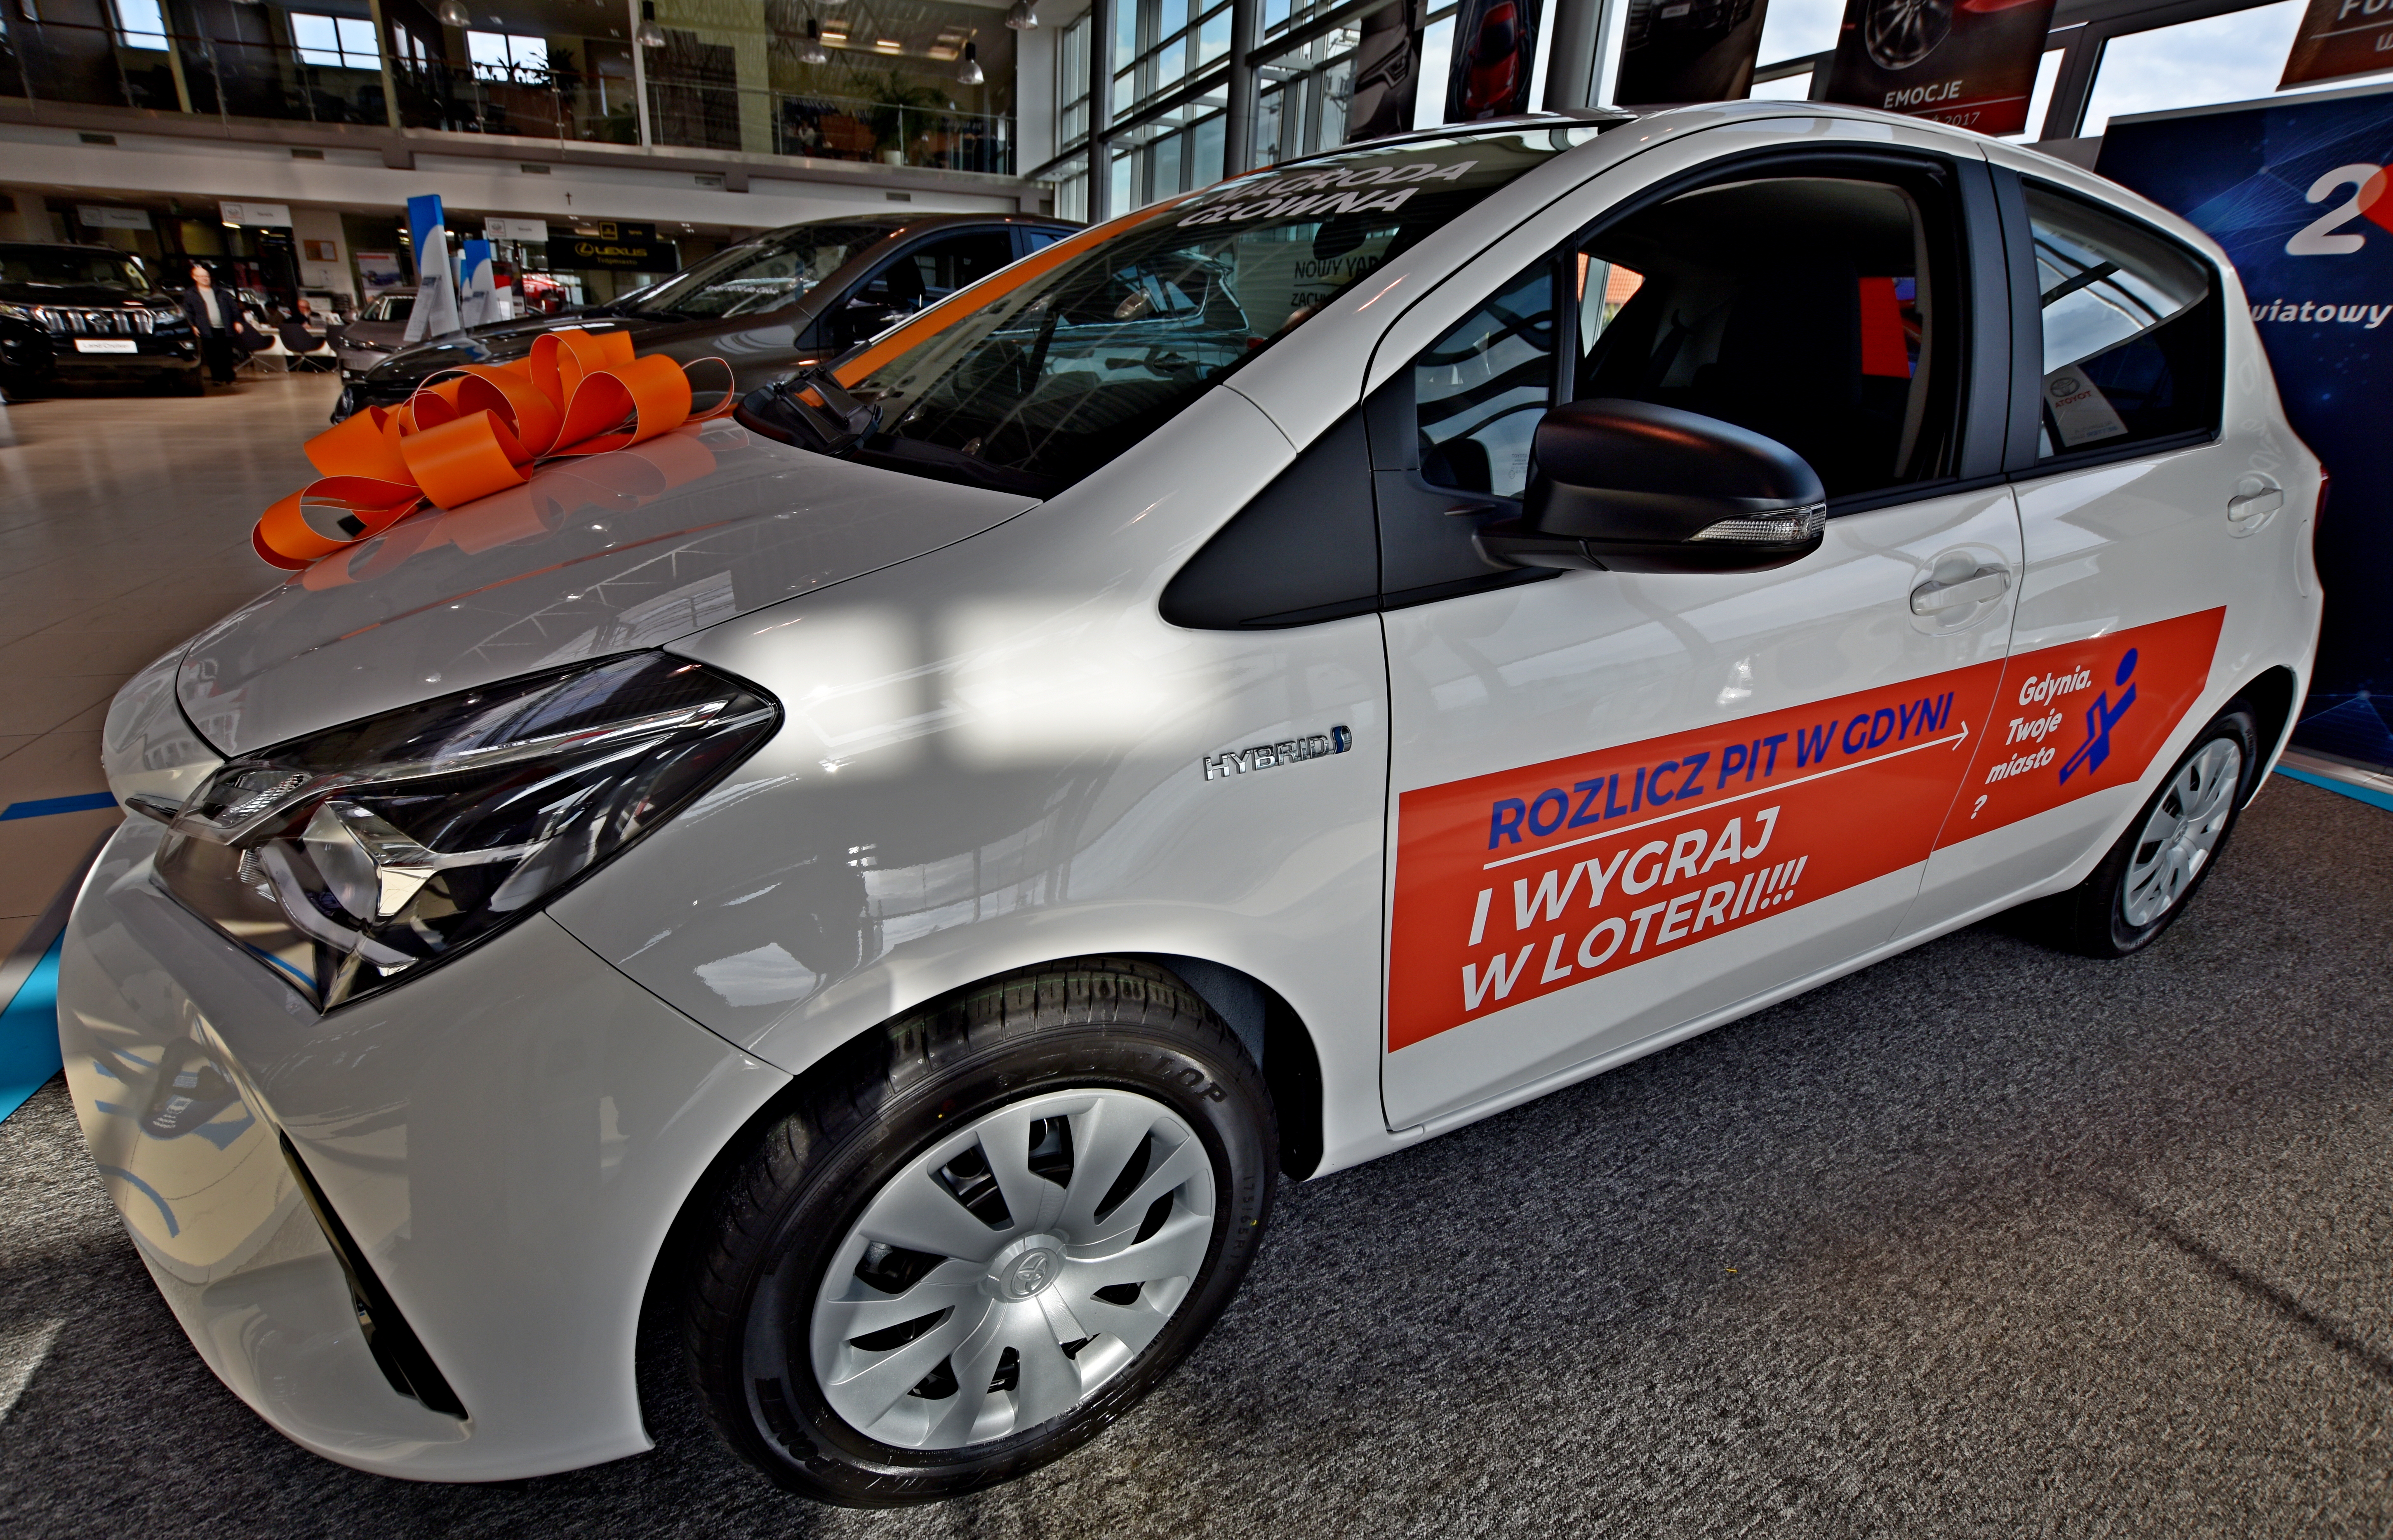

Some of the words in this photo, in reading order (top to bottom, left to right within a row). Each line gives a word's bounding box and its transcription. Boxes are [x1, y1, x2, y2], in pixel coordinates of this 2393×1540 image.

[1883, 80, 1963, 110] EMOCJE
[1945, 111, 1981, 127] 2017
[1202, 160, 1479, 205] NAGRODA
[595, 246, 648, 257] LEXUS
[1294, 259, 1343, 279] NOWY
[1346, 256, 1380, 277] YAR
[2249, 299, 2393, 329] wiatowy
[2019, 665, 2092, 706] Gdynia.
[2005, 708, 2062, 745] Twoje
[1202, 735, 1330, 781] HYBRID
[1488, 752, 1711, 850] ROZLICZ
[1717, 734, 1788, 790] PIT
[1797, 720, 1838, 768] W
[1842, 692, 1954, 755] GDYNI
[1984, 747, 2055, 785] miasto
[1468, 888, 1493, 947] I
[1513, 805, 1781, 931] WYGRAJ
[1462, 943, 1535, 1011] W
[1540, 855, 1808, 985] LOTERII!!!
[1026, 1046, 1229, 1103] DUNLOP
